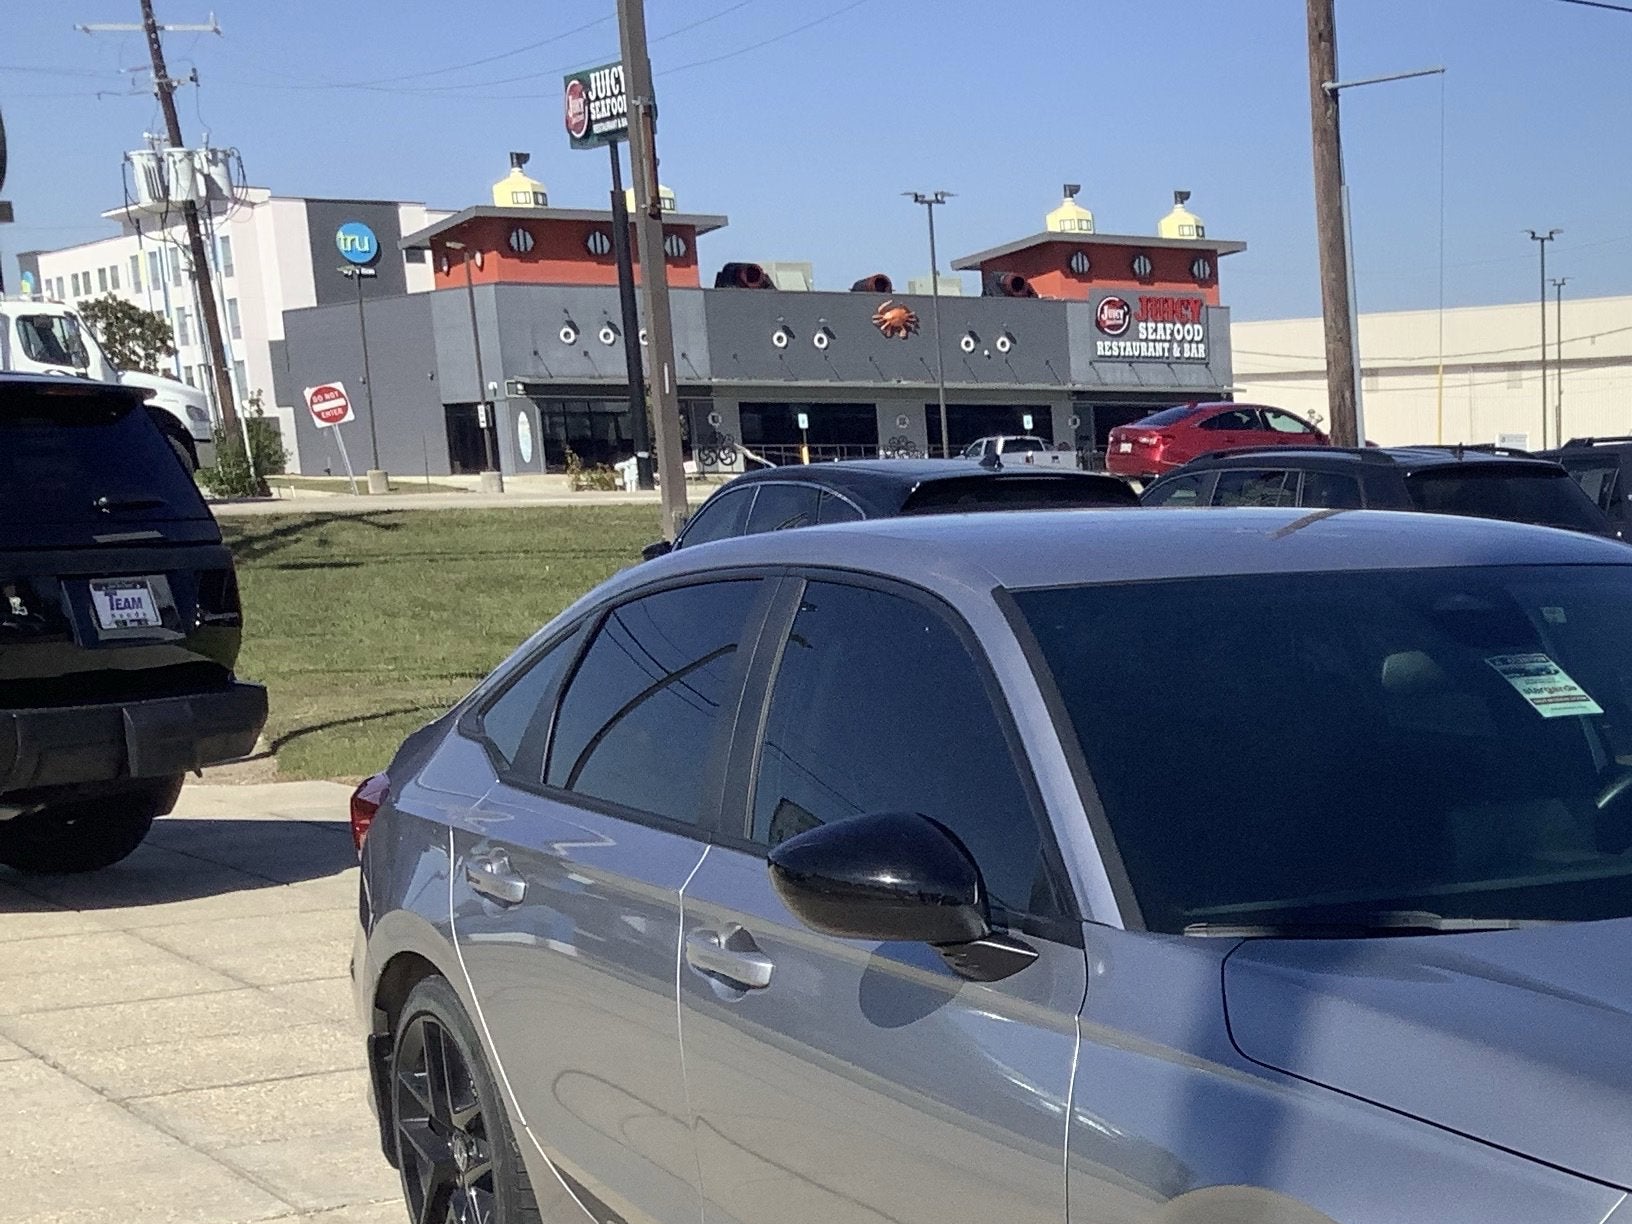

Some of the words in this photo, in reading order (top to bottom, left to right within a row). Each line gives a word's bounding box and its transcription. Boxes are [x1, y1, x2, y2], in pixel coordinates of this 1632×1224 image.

[588, 65, 625, 100] JUICY
[336, 231, 370, 251] tru
[1134, 296, 1203, 323] JUICY
[1138, 322, 1204, 341] SEAFOOD
[1097, 341, 1170, 358] RESTAURANT
[1173, 344, 1181, 357] &
[1183, 343, 1206, 358] BAR
[312, 393, 323, 402] DO
[324, 390, 340, 400] NOT
[321, 407, 344, 418] ENTER
